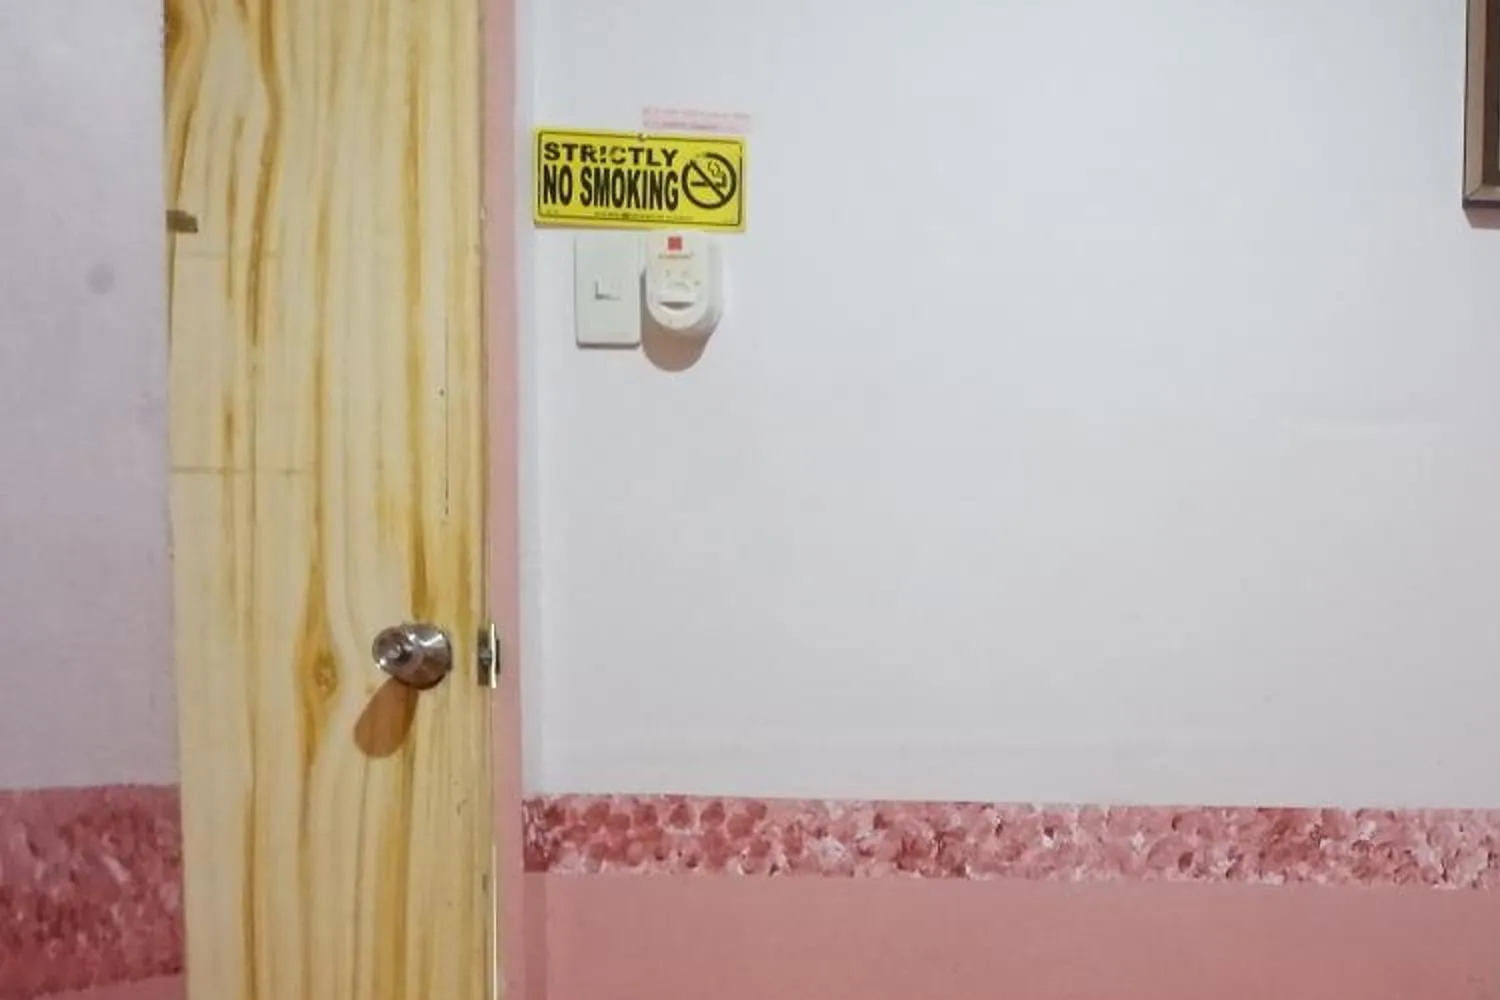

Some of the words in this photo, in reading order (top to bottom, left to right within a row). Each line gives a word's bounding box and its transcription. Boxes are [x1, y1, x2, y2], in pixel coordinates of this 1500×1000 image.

[544, 142, 679, 167] STRICTLY
[544, 164, 572, 206] NO
[580, 165, 679, 211] SMOKING
